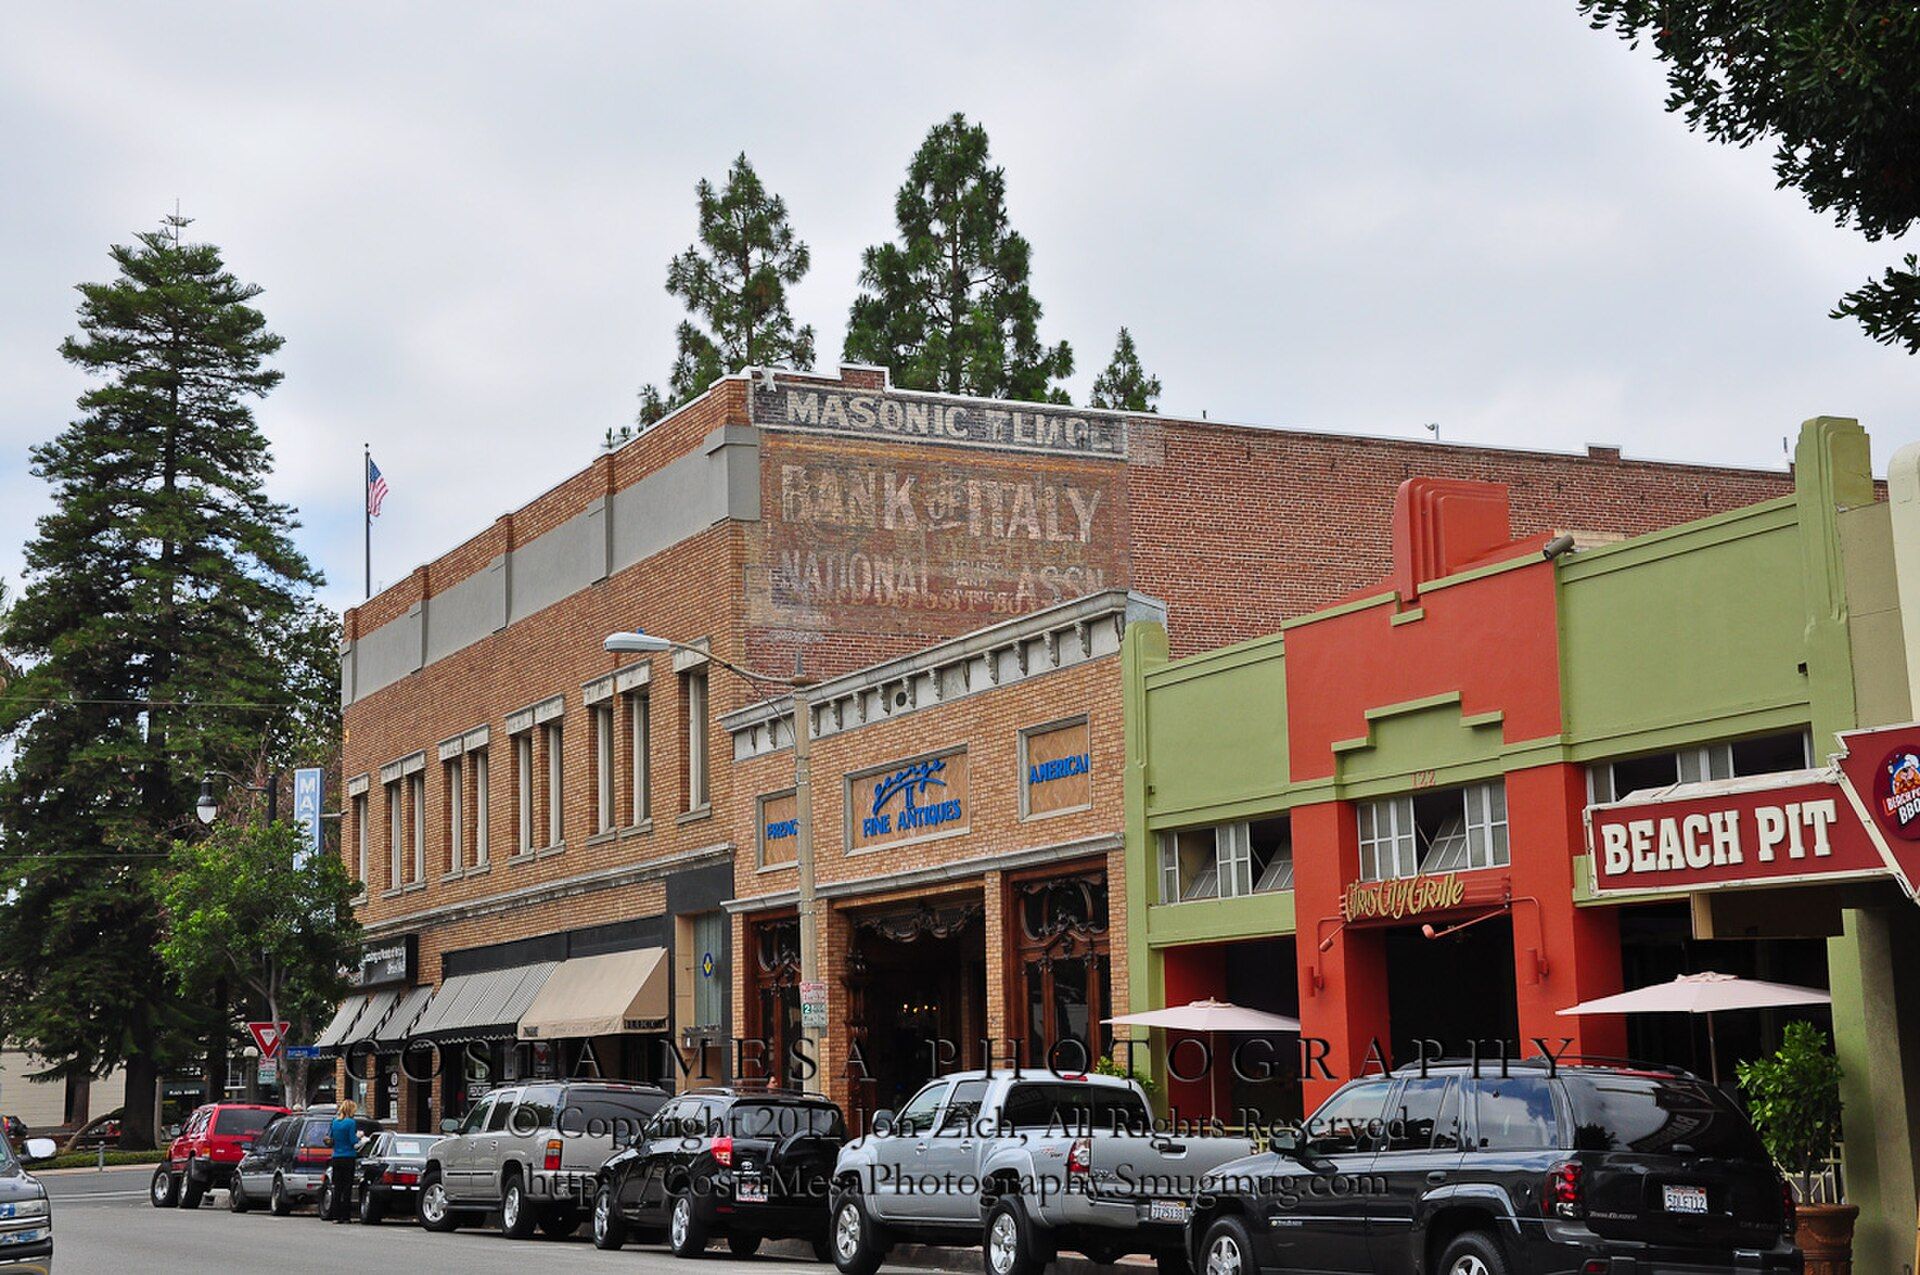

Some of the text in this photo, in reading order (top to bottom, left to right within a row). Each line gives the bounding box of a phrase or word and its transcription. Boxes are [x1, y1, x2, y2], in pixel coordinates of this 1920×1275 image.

[786, 391, 970, 439] MASONIC
[863, 798, 962, 838] FINE ANTIQUES
[1601, 799, 1837, 876] BEACH PIT
